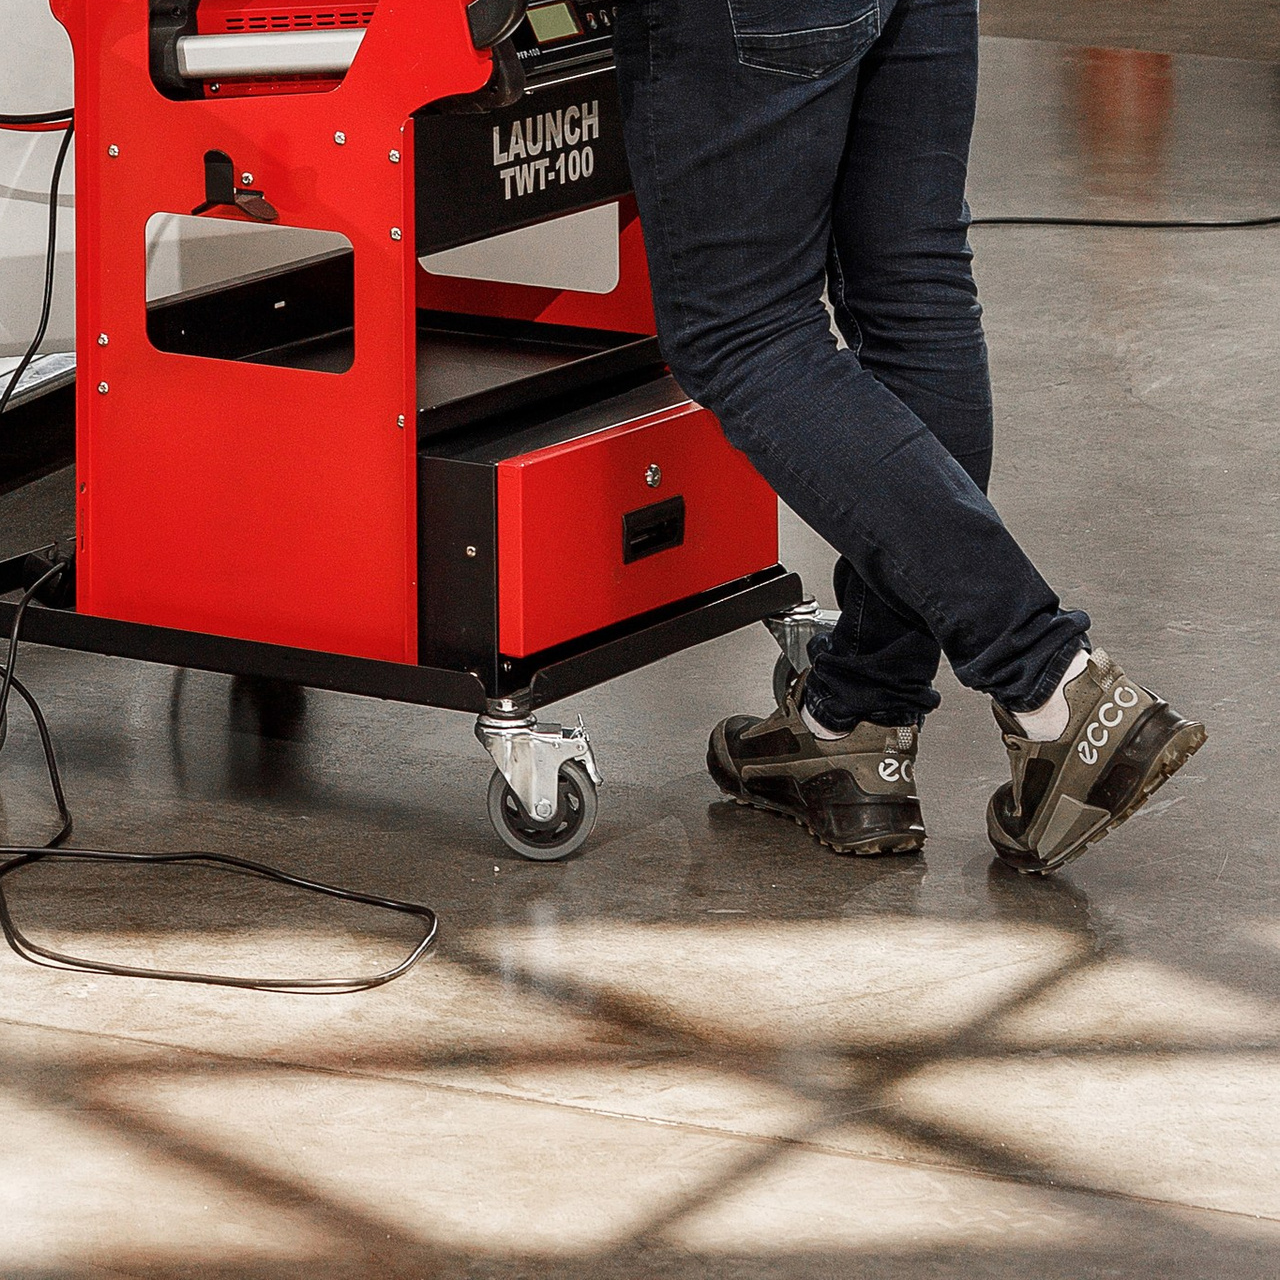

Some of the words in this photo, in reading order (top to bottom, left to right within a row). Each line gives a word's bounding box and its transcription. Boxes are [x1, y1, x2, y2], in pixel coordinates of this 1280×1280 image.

[492, 99, 599, 167] LAUNCH
[499, 145, 595, 200] TWT-100
[1077, 685, 1139, 765] ecco
